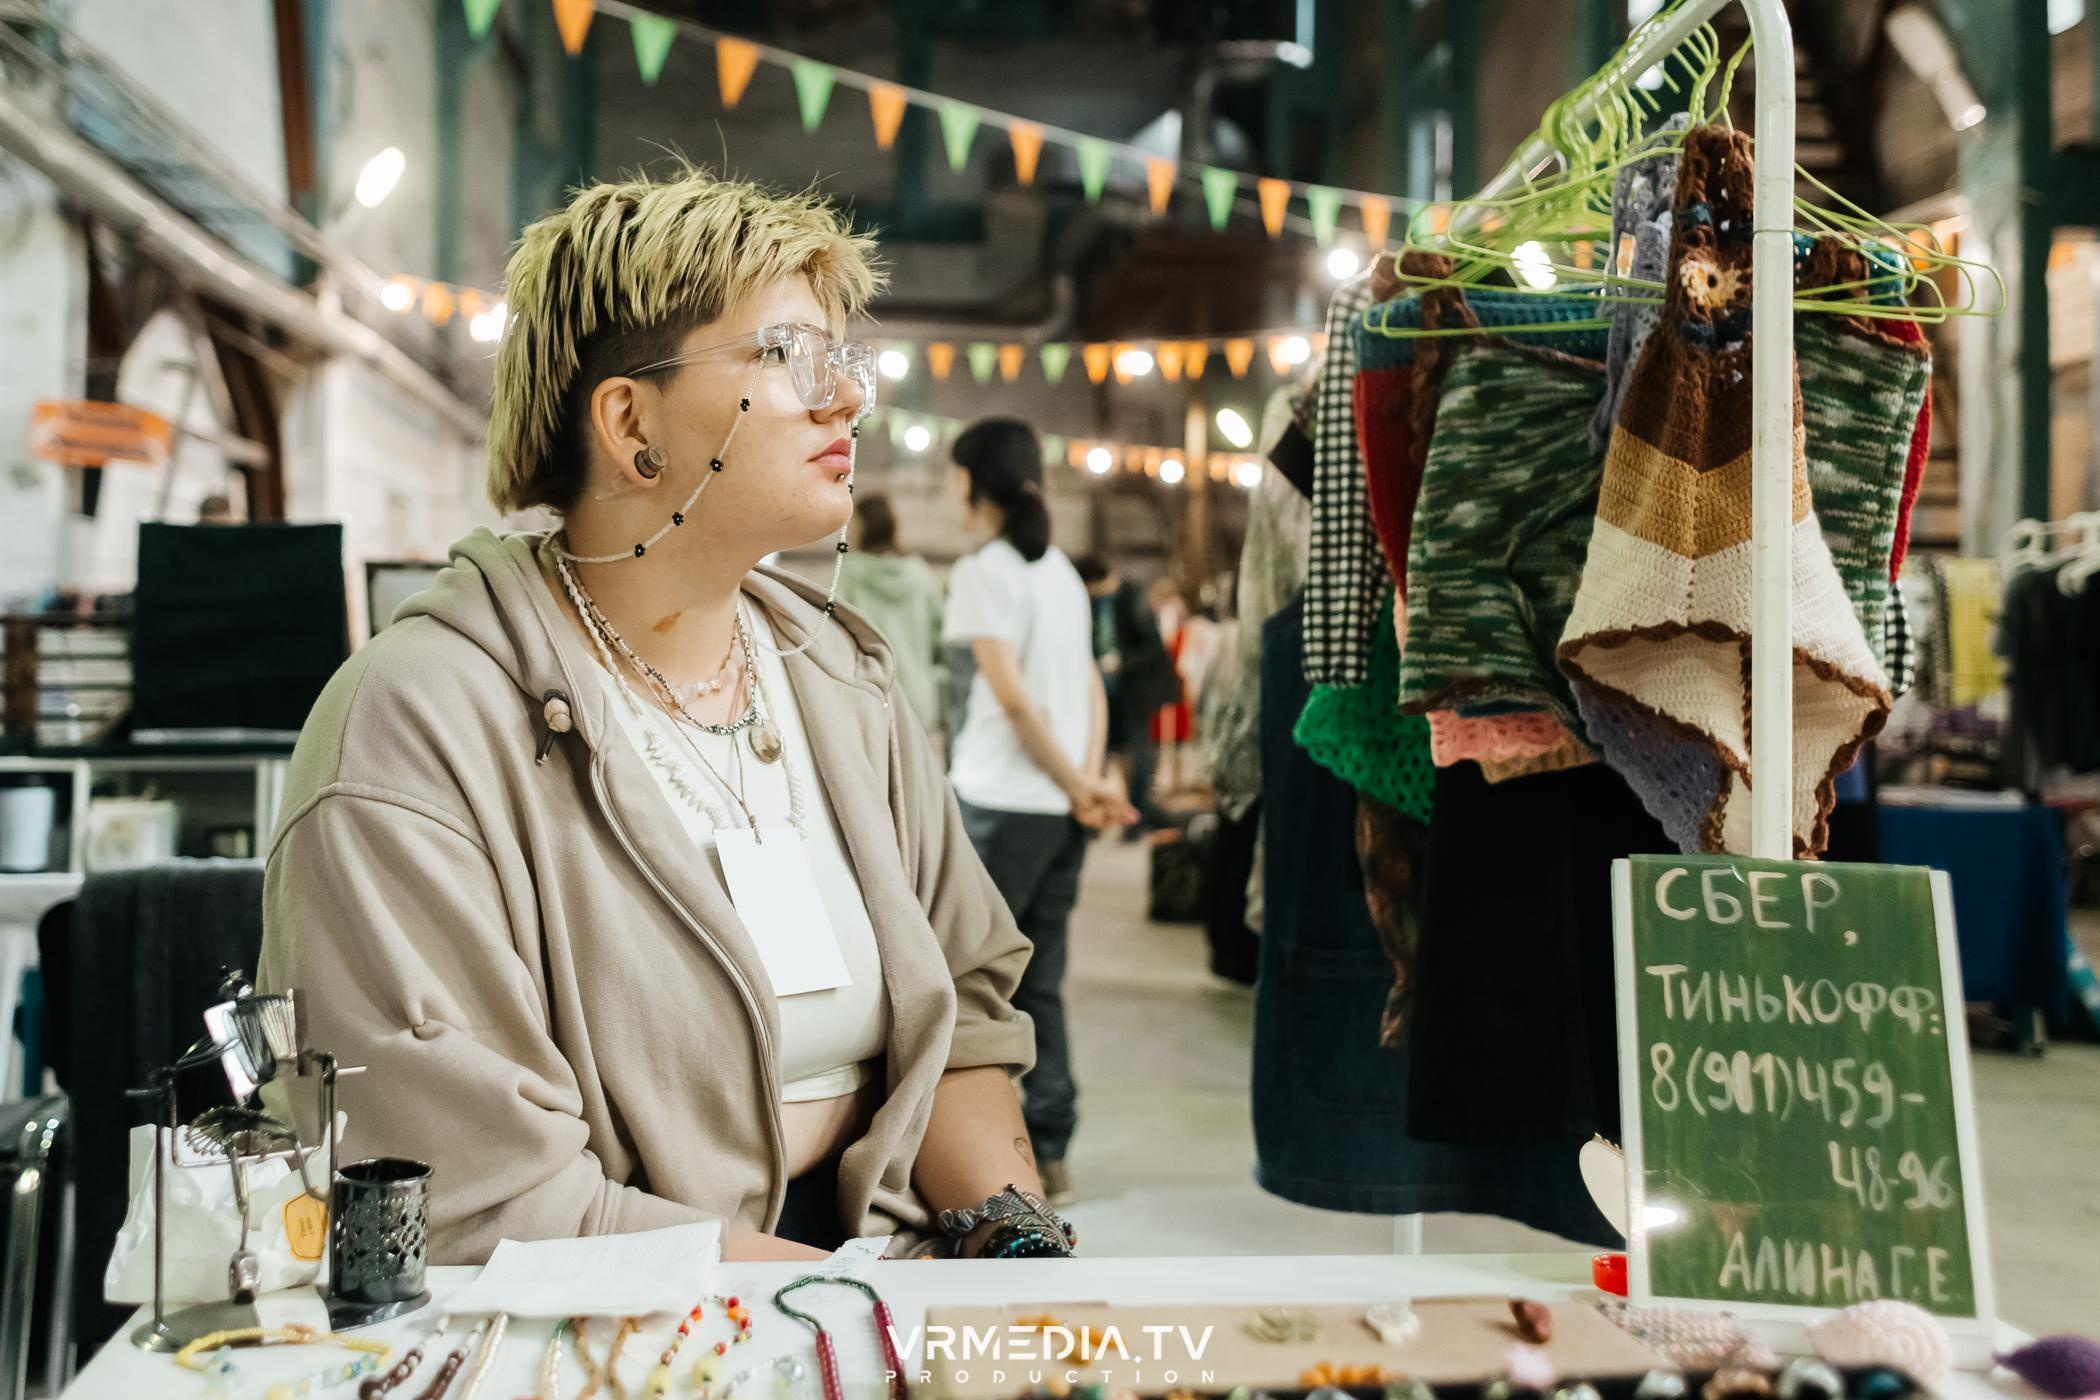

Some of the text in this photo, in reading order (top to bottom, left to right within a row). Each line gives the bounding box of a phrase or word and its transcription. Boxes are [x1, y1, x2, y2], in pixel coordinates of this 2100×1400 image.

[1655, 867, 1859, 946] СБЕР,
[1645, 964, 1941, 1035] ТИНЬКОФФ:
[1828, 1140, 1955, 1211] 48-96
